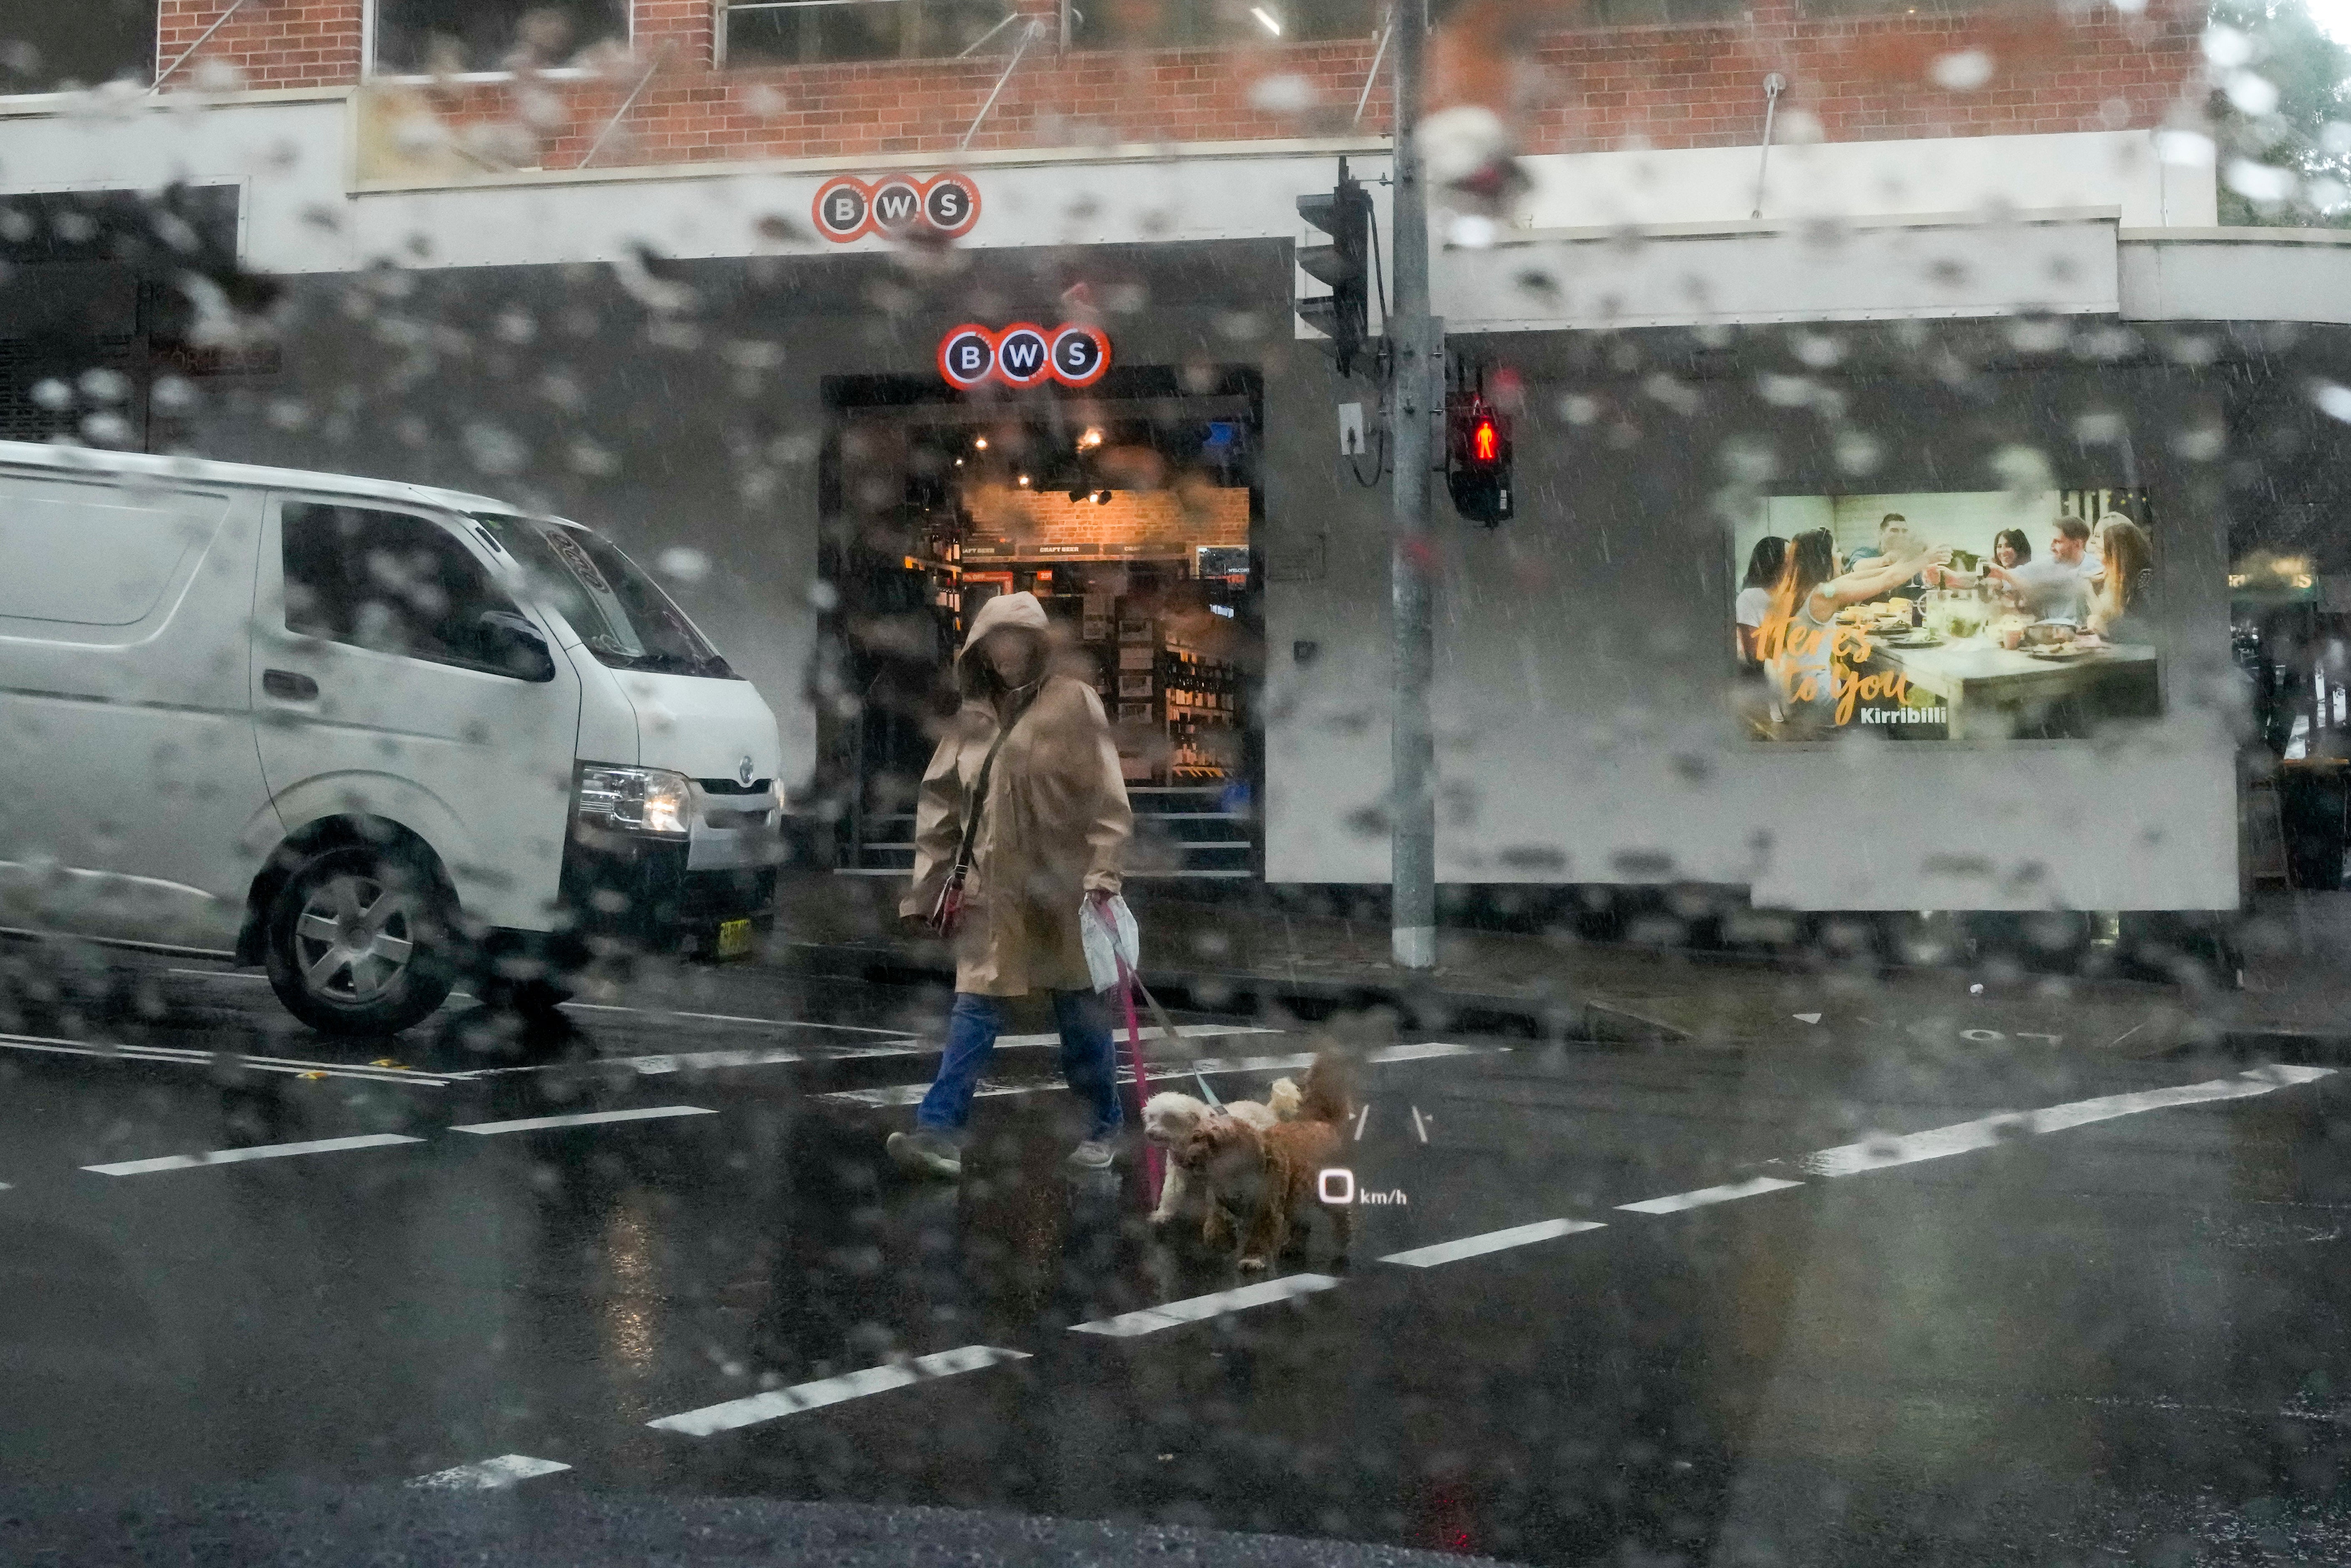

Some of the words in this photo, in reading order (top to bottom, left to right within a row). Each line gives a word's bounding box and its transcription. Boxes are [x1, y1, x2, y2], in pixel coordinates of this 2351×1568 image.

[836, 194, 957, 220] BWS
[962, 342, 1086, 369] BWS
[1861, 707, 1947, 724] Kirribilli
[1360, 1188, 1407, 1204] km/h
